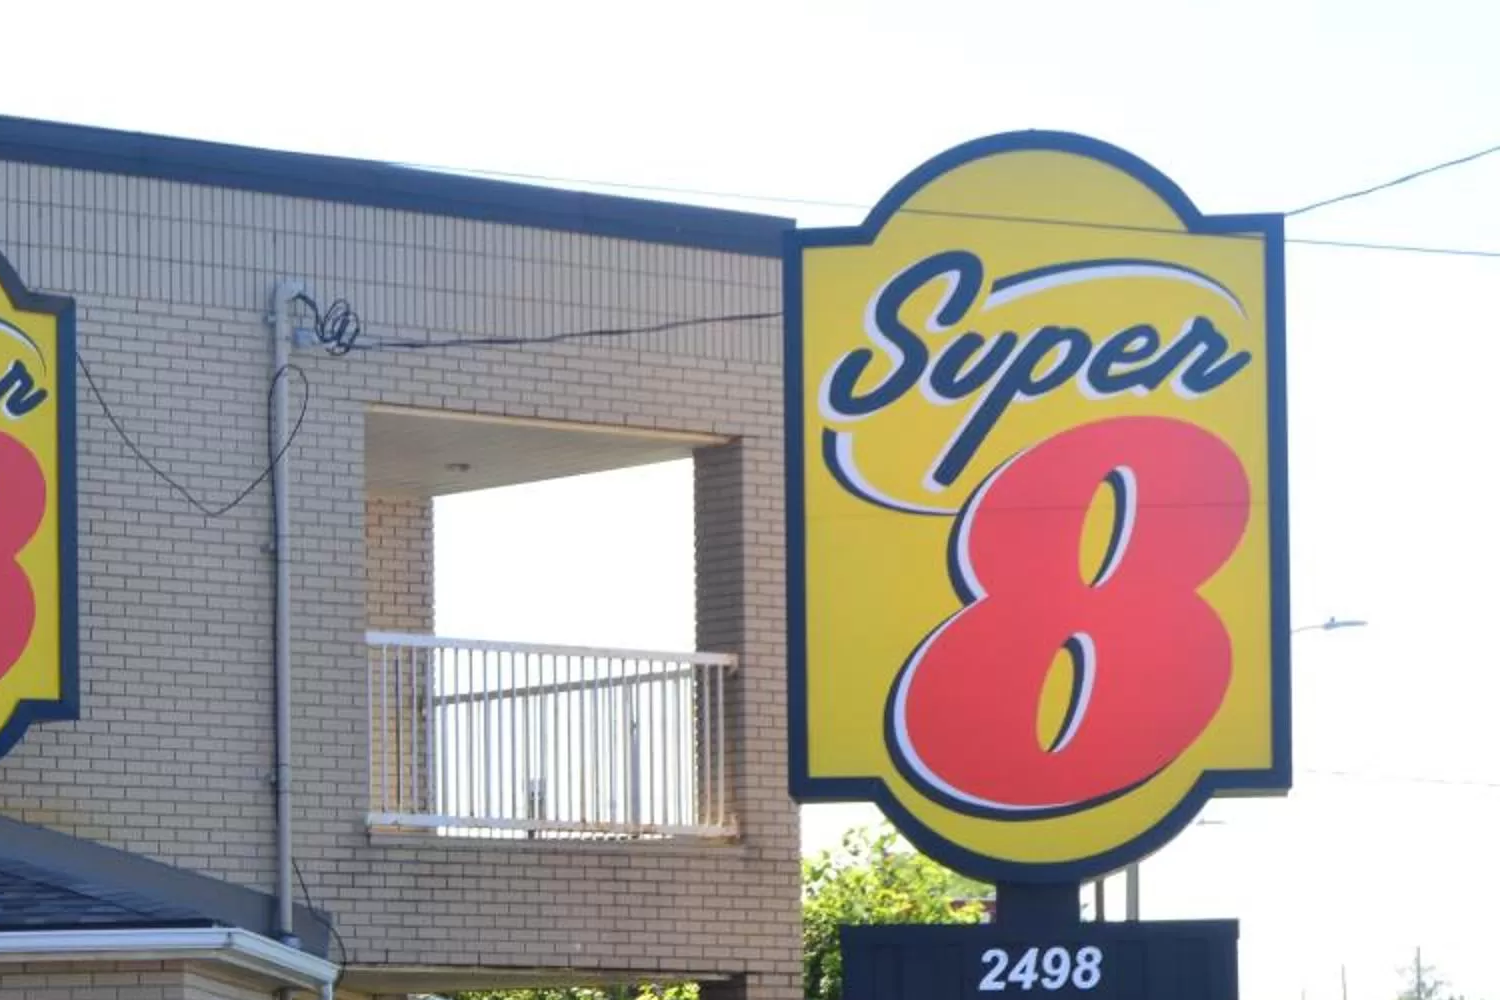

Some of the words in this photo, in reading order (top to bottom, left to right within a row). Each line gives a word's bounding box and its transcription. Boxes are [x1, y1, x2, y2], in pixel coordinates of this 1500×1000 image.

[820, 249, 1252, 494] Super
[883, 414, 1252, 822] 8
[978, 945, 1104, 992] 2498
